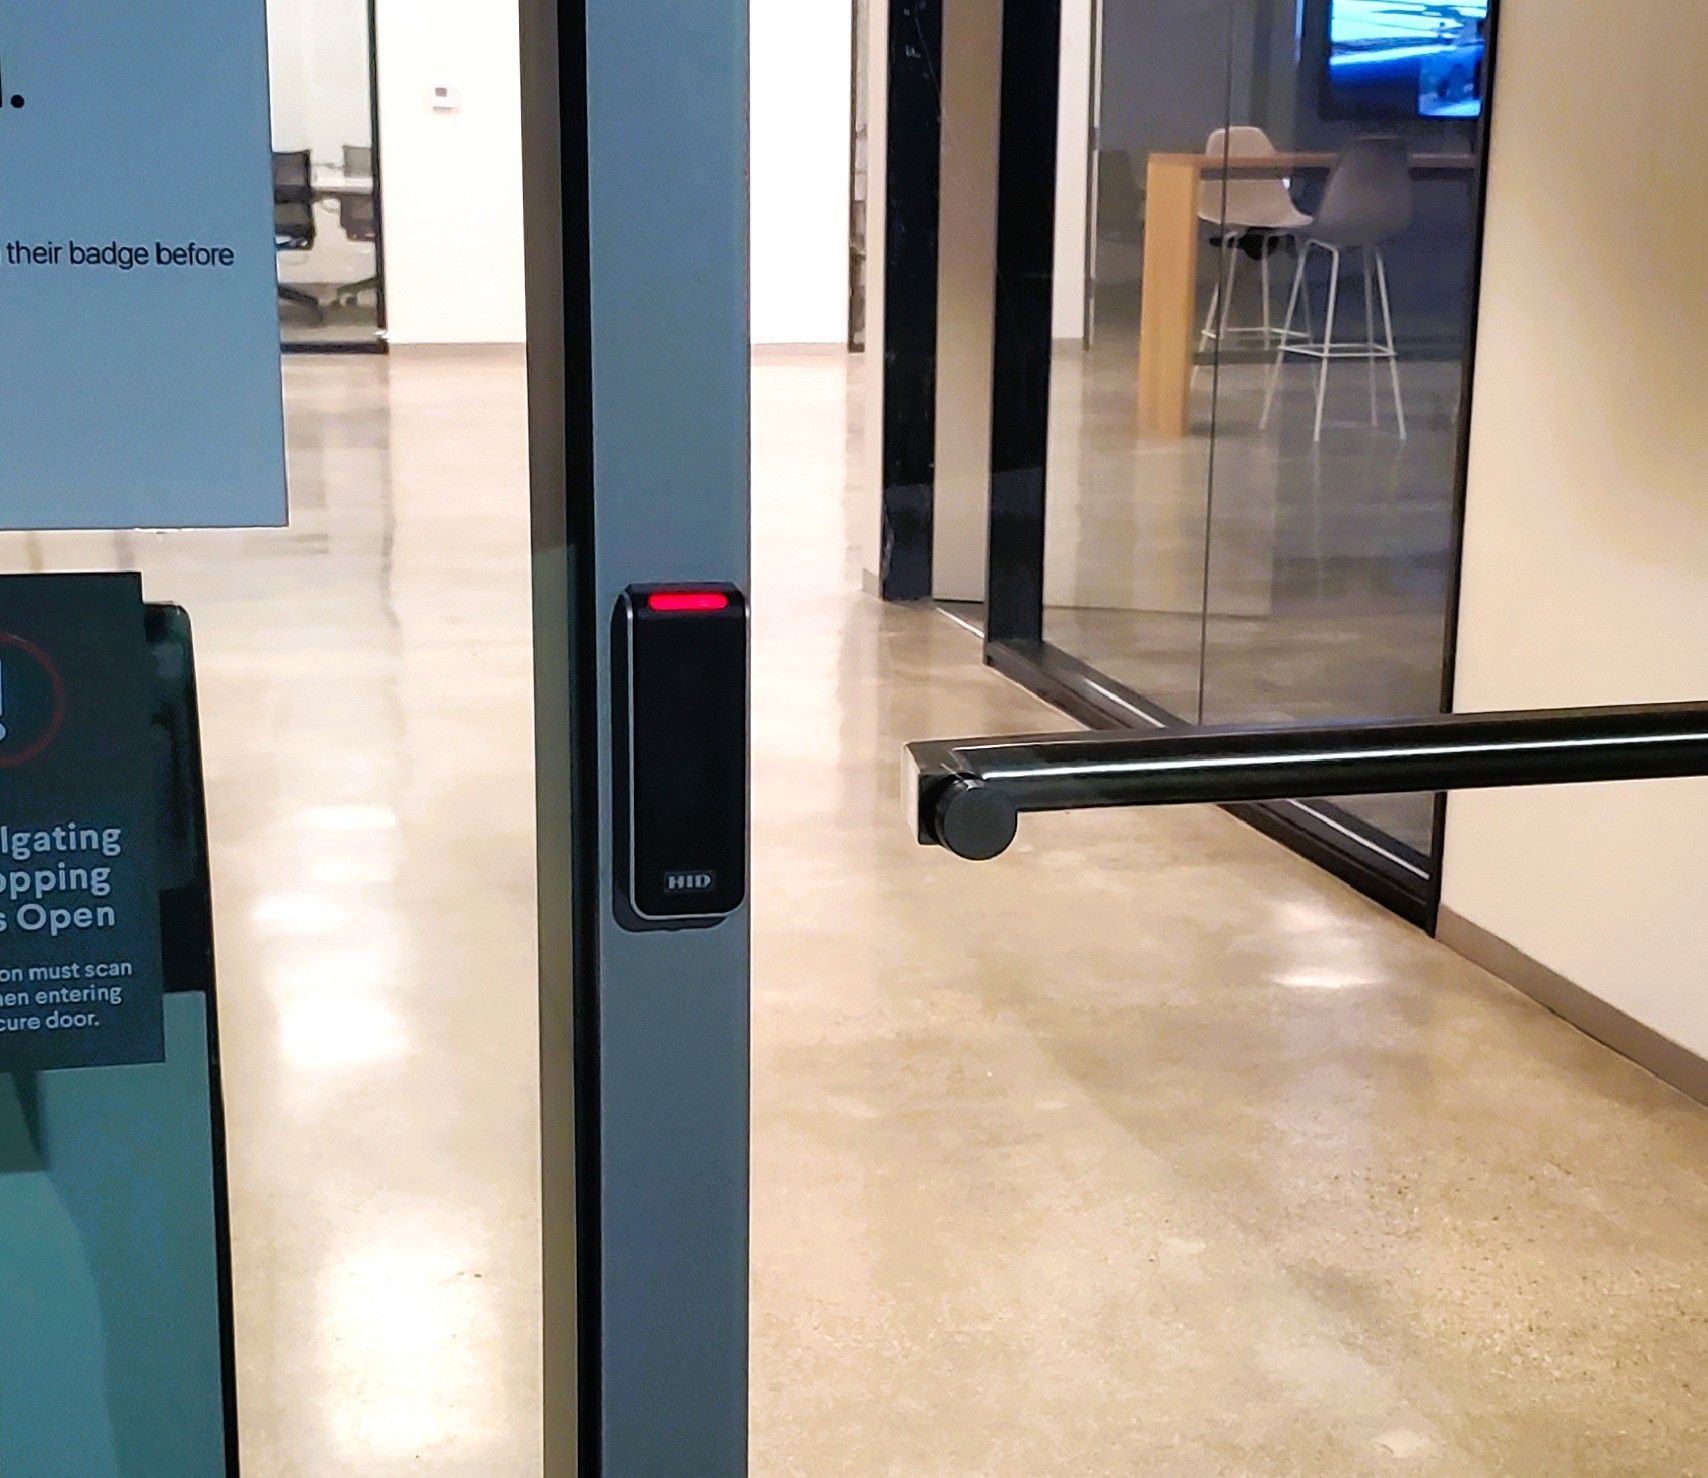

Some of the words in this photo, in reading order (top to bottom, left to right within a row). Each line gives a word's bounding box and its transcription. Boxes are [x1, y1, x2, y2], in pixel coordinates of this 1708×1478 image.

[6, 240, 63, 264] their
[69, 240, 149, 270] badge
[155, 242, 235, 266] before
[0, 822, 122, 861] lgating
[669, 875, 711, 889] HID
[16, 902, 116, 937] Open
[0, 968, 23, 982] on
[28, 963, 80, 981] must
[84, 961, 132, 977] scan
[35, 984, 122, 1004] entering
[45, 1010, 100, 1029] door.
